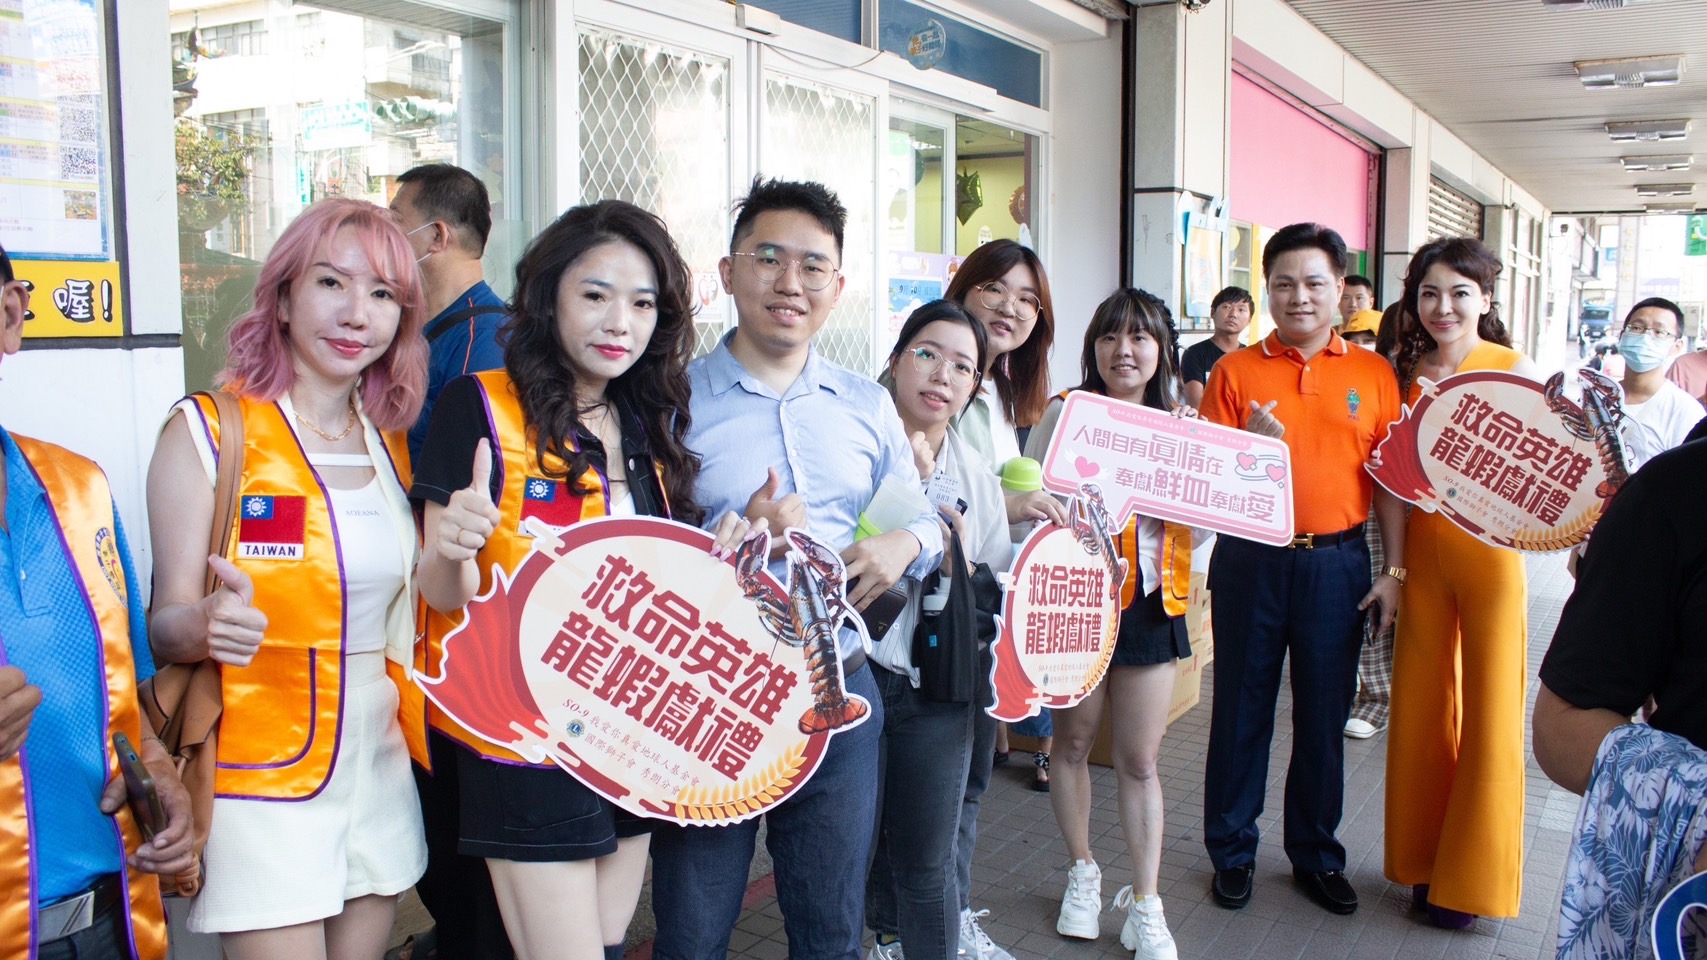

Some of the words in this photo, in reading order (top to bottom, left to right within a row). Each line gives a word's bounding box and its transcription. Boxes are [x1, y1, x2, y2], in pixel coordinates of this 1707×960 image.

[19, 279, 113, 323] 喔!
[1451, 392, 1593, 493] 救命英雄
[1115, 467, 1276, 523] 奉獻鮮血奉獻愛
[1429, 426, 1571, 527] 龍蝦獻禮
[245, 545, 296, 556] TAIWAN
[1028, 563, 1105, 608] 救命英雄
[581, 554, 799, 726] 救命英雄
[1025, 611, 1102, 655] 龍蝦獻禮
[540, 611, 764, 781] 龍蝦獻禮
[562, 698, 590, 718] SO-9
[590, 715, 700, 787] 我愛你真愛地球人基金會
[584, 732, 636, 769] 國際獅子會
